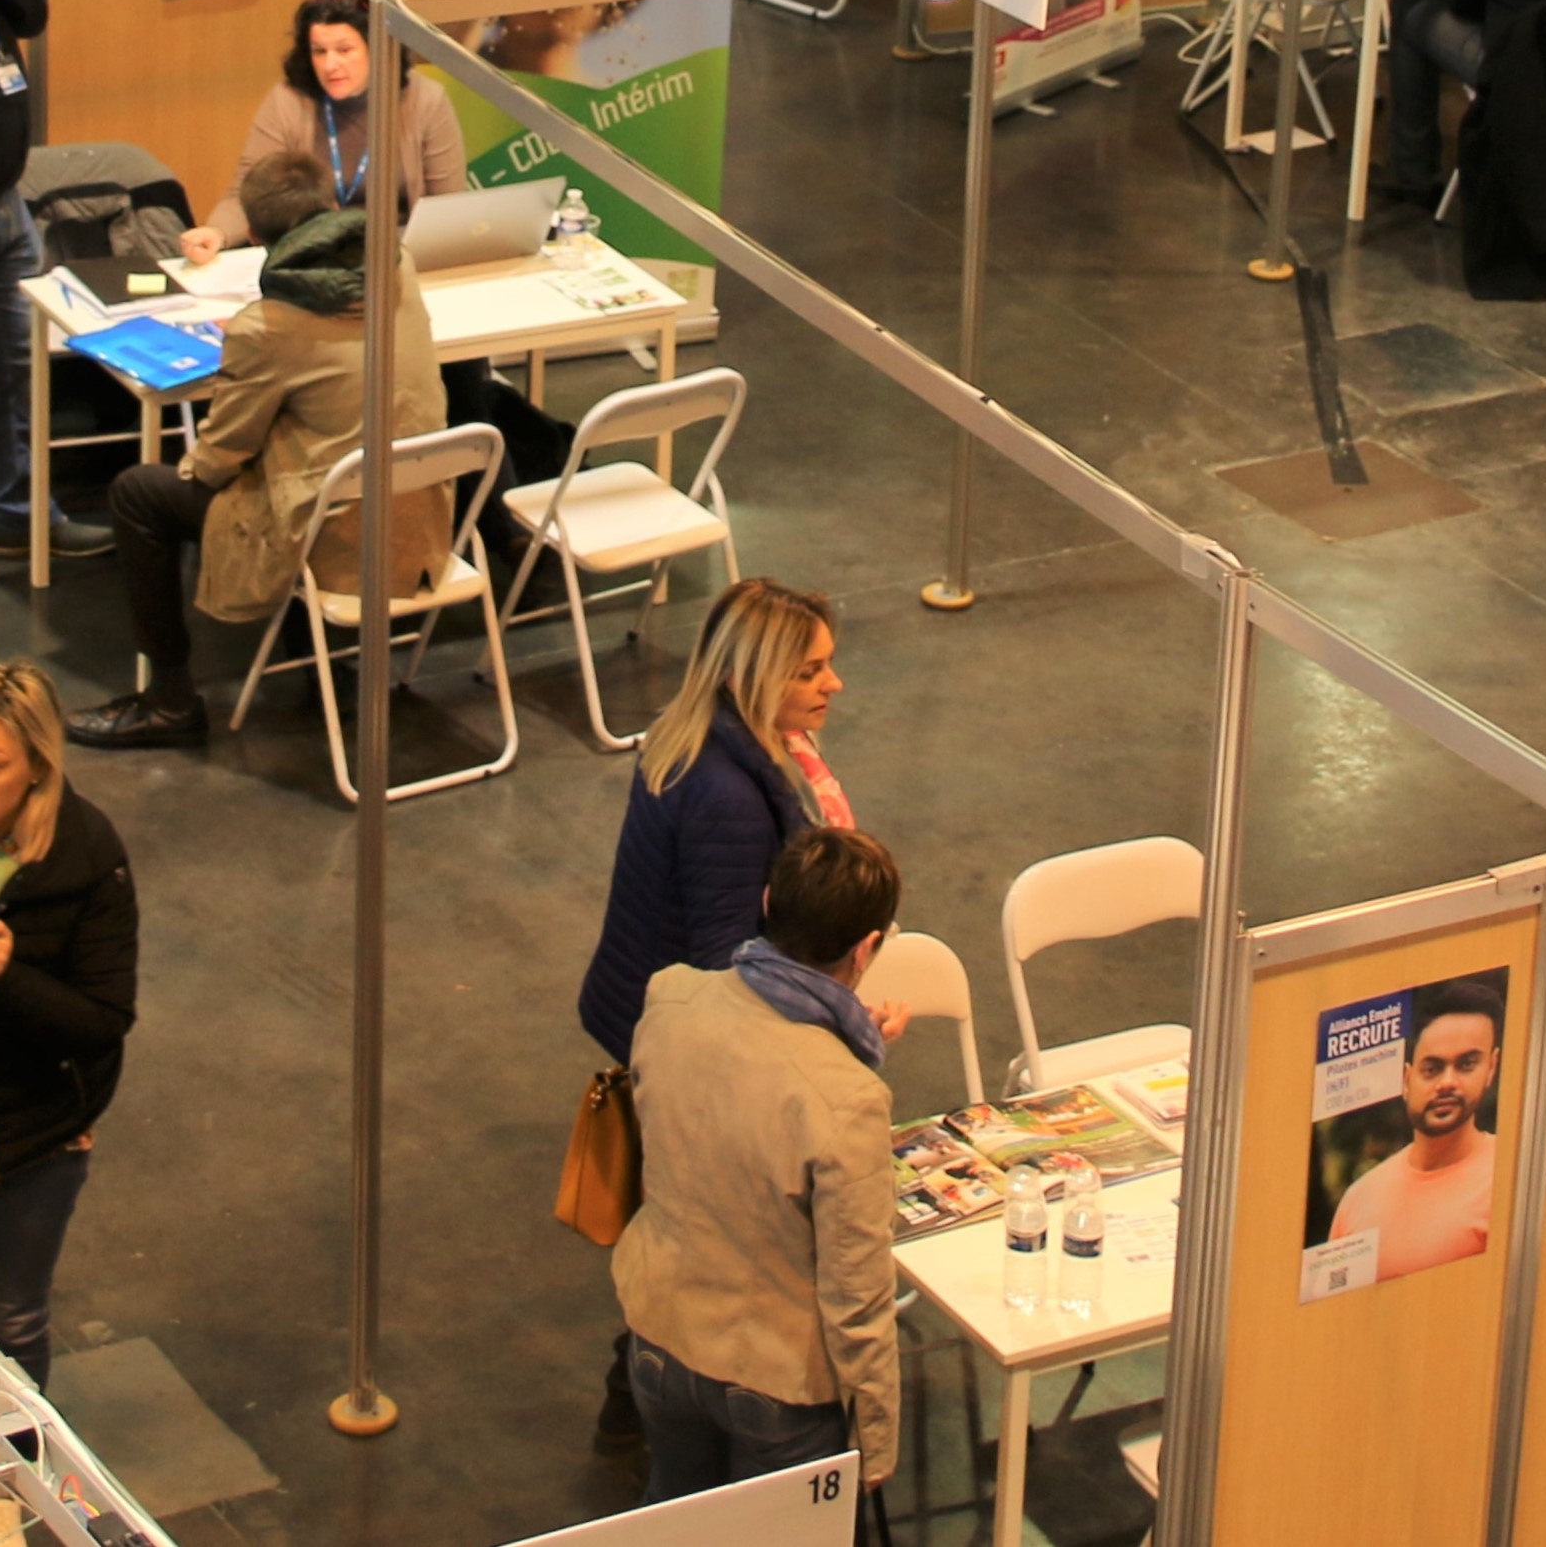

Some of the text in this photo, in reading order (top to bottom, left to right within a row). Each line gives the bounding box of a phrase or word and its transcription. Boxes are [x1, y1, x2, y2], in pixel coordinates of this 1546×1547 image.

[590, 70, 694, 132] Intérim
[1328, 1002, 1402, 1035] Alliance Emploi
[1327, 1017, 1402, 1059] RECRUTE
[809, 1470, 841, 1505] 18
